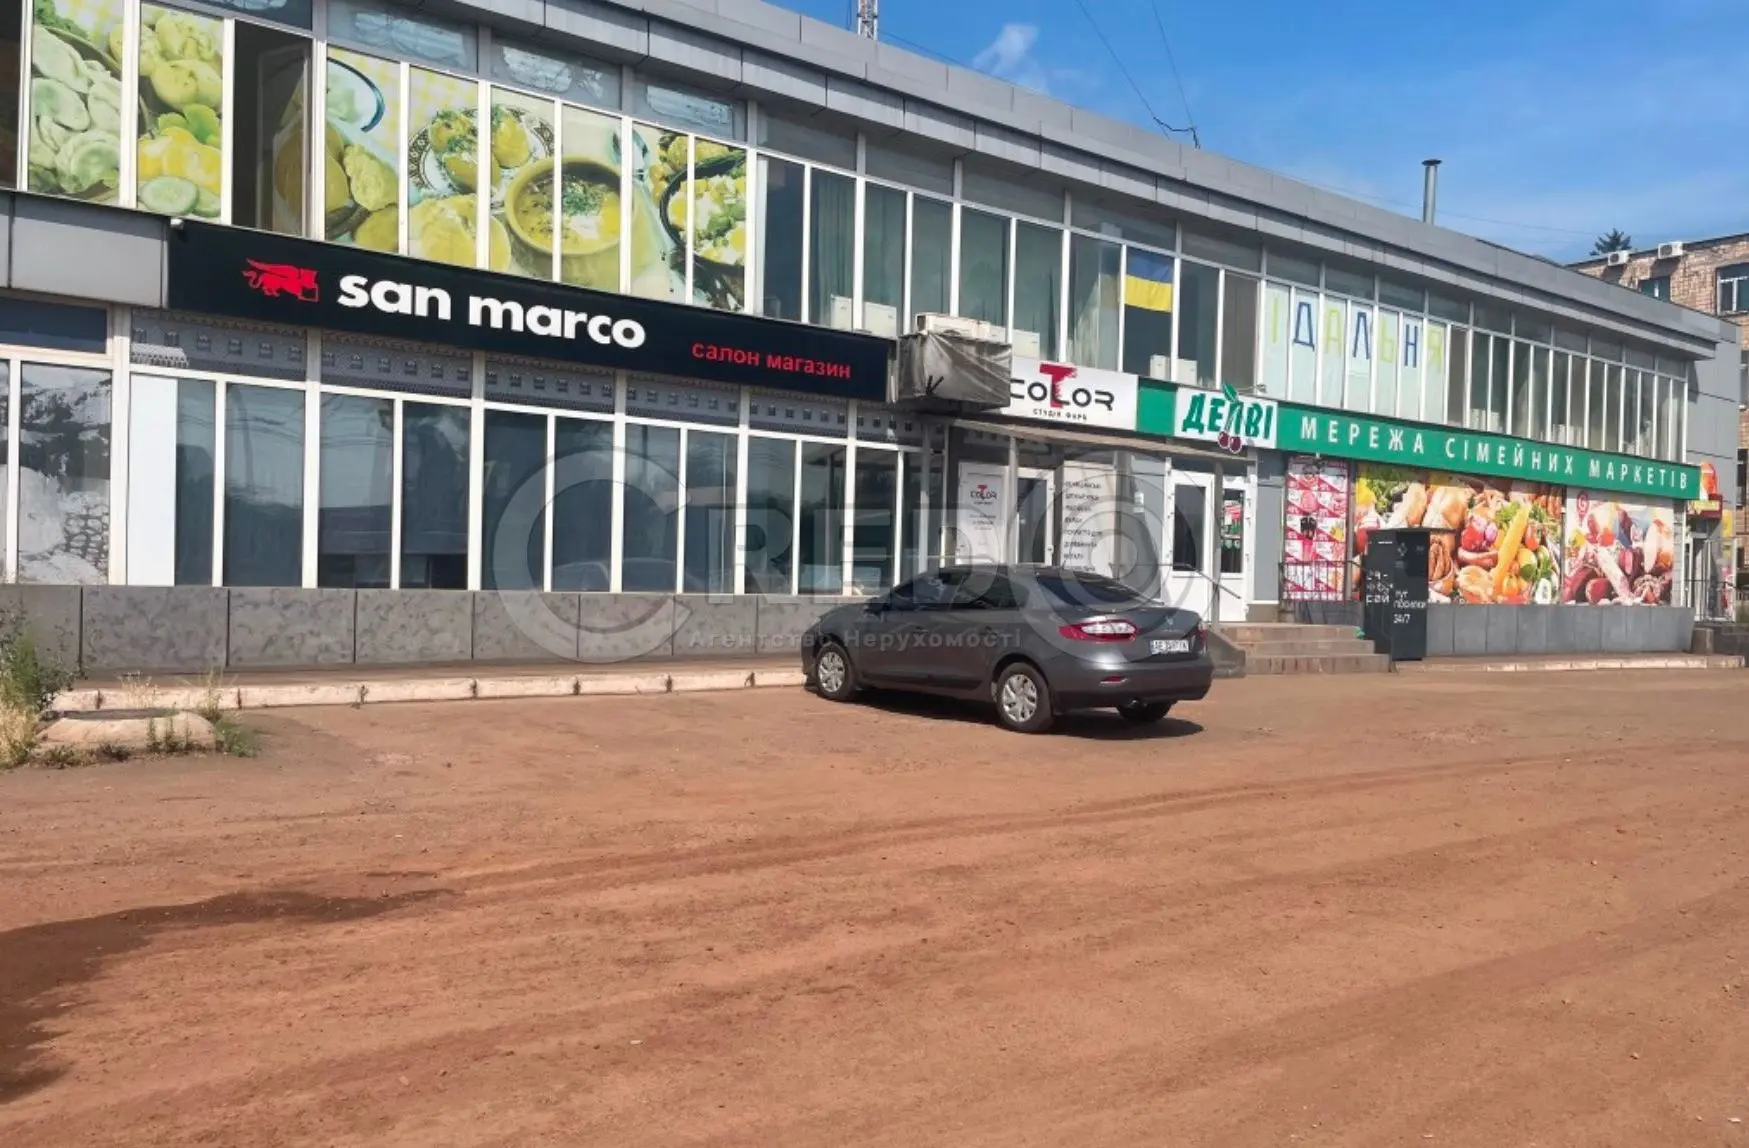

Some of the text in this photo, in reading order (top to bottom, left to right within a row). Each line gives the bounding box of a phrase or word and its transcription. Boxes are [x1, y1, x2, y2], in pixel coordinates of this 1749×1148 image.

[336, 272, 647, 350] san marco
[691, 340, 852, 380] салон магазин
[1181, 392, 1274, 440] ДЕЛВІ
[1300, 415, 1688, 489] МЕРЕЖА СІМЕЙНИХ МАРКЕТІВ
